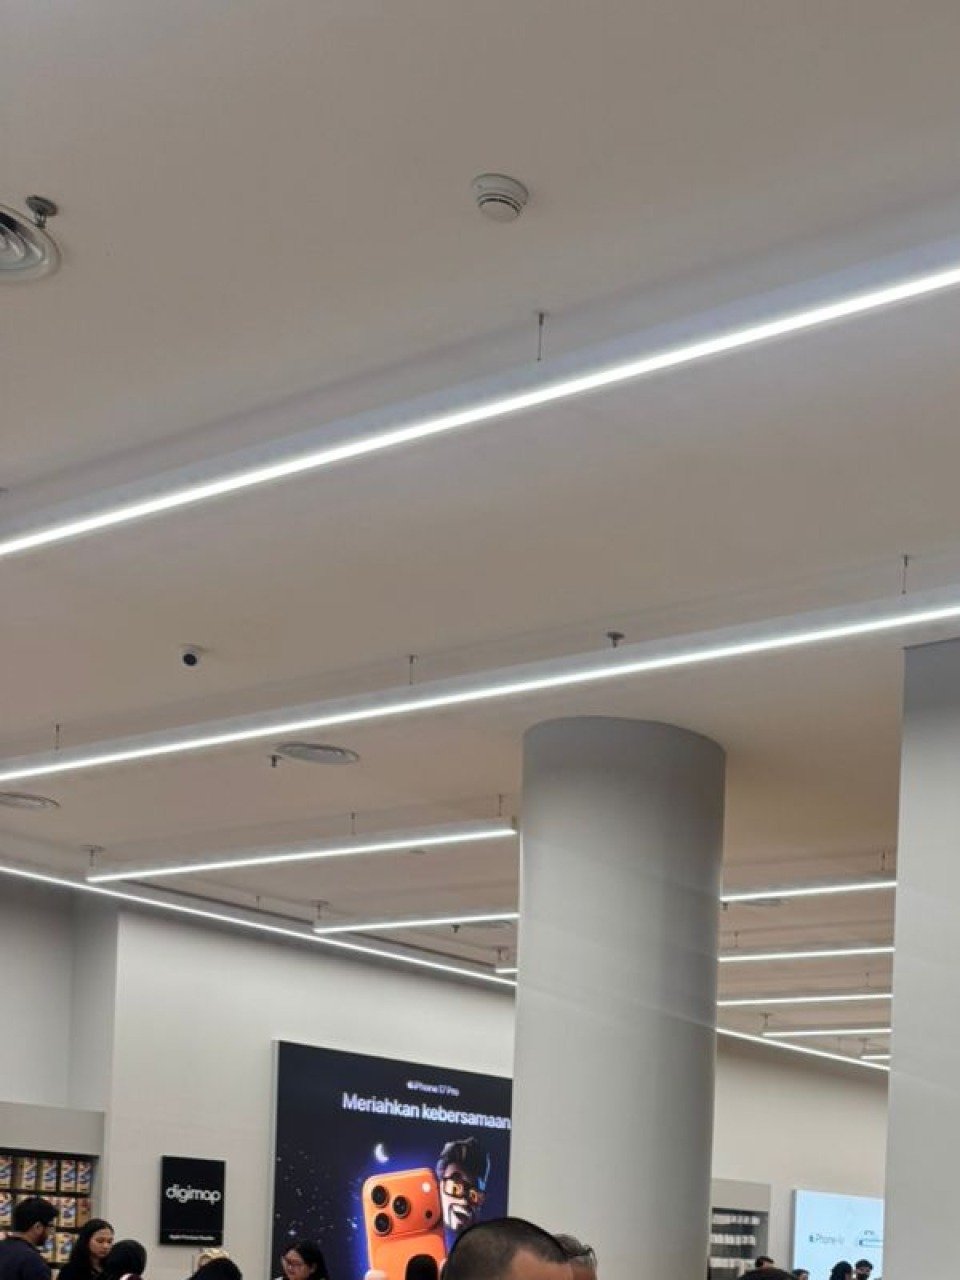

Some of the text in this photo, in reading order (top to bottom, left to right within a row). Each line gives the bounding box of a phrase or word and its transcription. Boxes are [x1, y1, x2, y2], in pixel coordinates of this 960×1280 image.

[342, 1091, 512, 1129] Meriahkan kebersamaan
[166, 1184, 221, 1205] digimap
